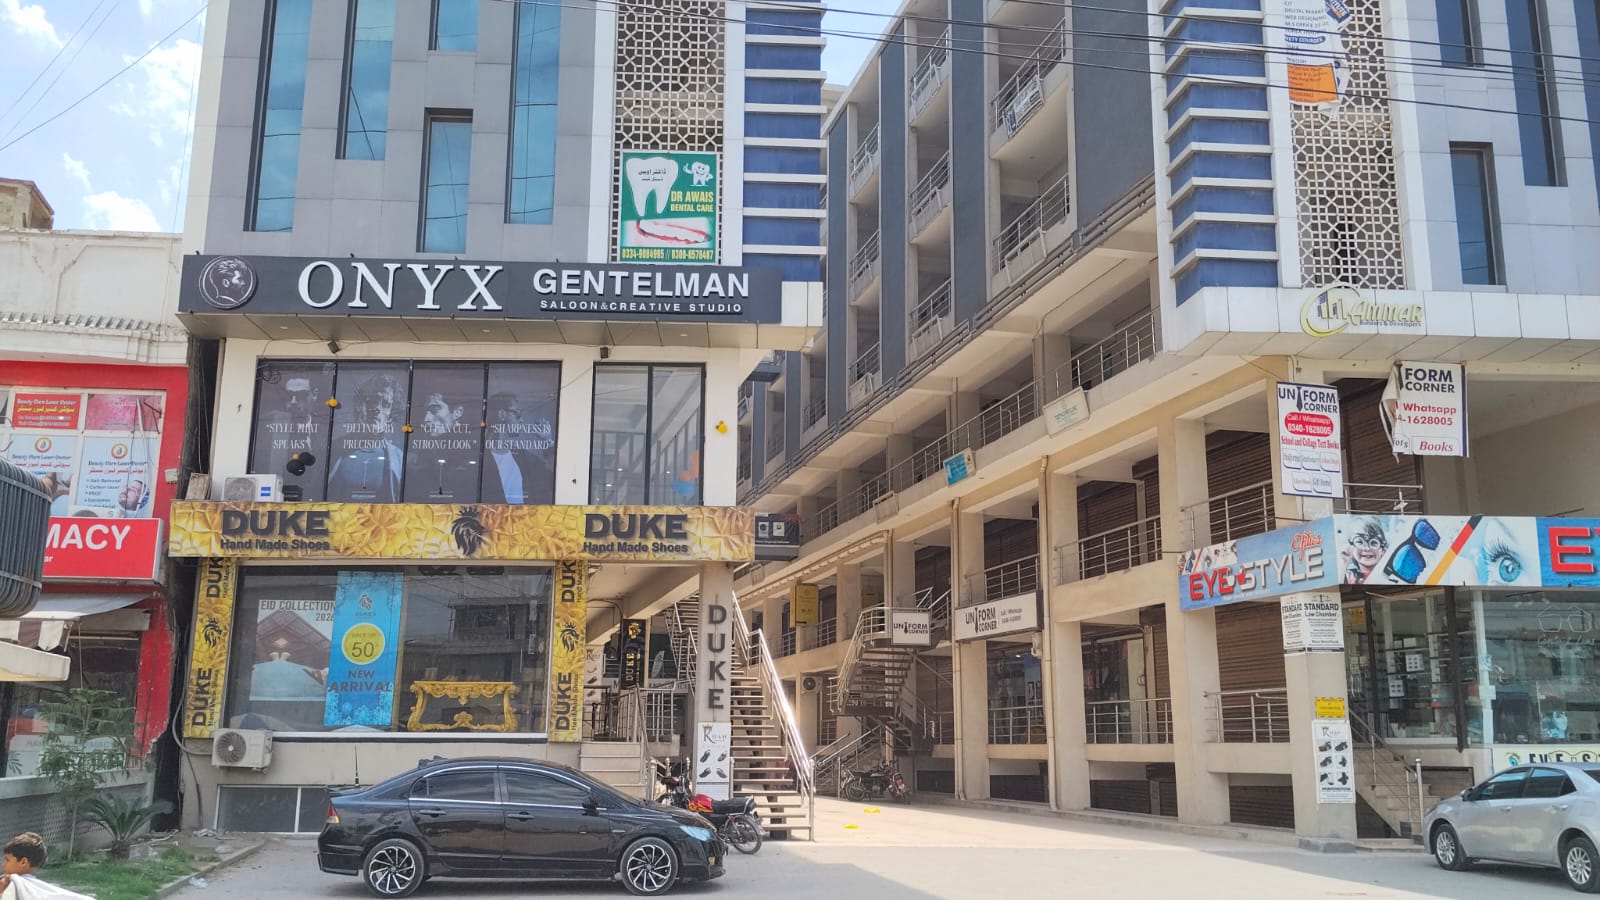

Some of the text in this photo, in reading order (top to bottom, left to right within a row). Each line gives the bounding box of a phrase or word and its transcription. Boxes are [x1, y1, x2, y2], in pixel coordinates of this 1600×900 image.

[670, 191, 713, 202] DR AWAIS
[670, 204, 713, 212] DENTAL CARE
[297, 261, 503, 312] ONYX
[532, 268, 749, 298] GENTELMAN
[689, 303, 742, 313] STUDIO
[1405, 381, 1455, 393] CORNER
[1303, 402, 1338, 414] CORNER
[1403, 402, 1457, 415] Whatsapp
[412, 439, 446, 450] STRONG
[485, 439, 505, 450] OUR
[1418, 440, 1454, 452] Books
[221, 510, 330, 536] DUKE
[583, 513, 688, 539] DUKE
[220, 538, 330, 550] Hand Made Shoes
[583, 541, 688, 553] Hand Made Shoes
[1548, 526, 1600, 573] E
[1188, 566, 1234, 600] EYE
[260, 600, 276, 610] EID
[1303, 603, 1339, 611] STANDARD
[978, 620, 998, 632] CORNER
[351, 641, 374, 658] 50
[626, 653, 635, 681] DUKE
[347, 670, 375, 679] NEW
[328, 681, 392, 692] ARRIVAL
[191, 668, 212, 727] DUKE
[555, 672, 571, 731] DUKE
